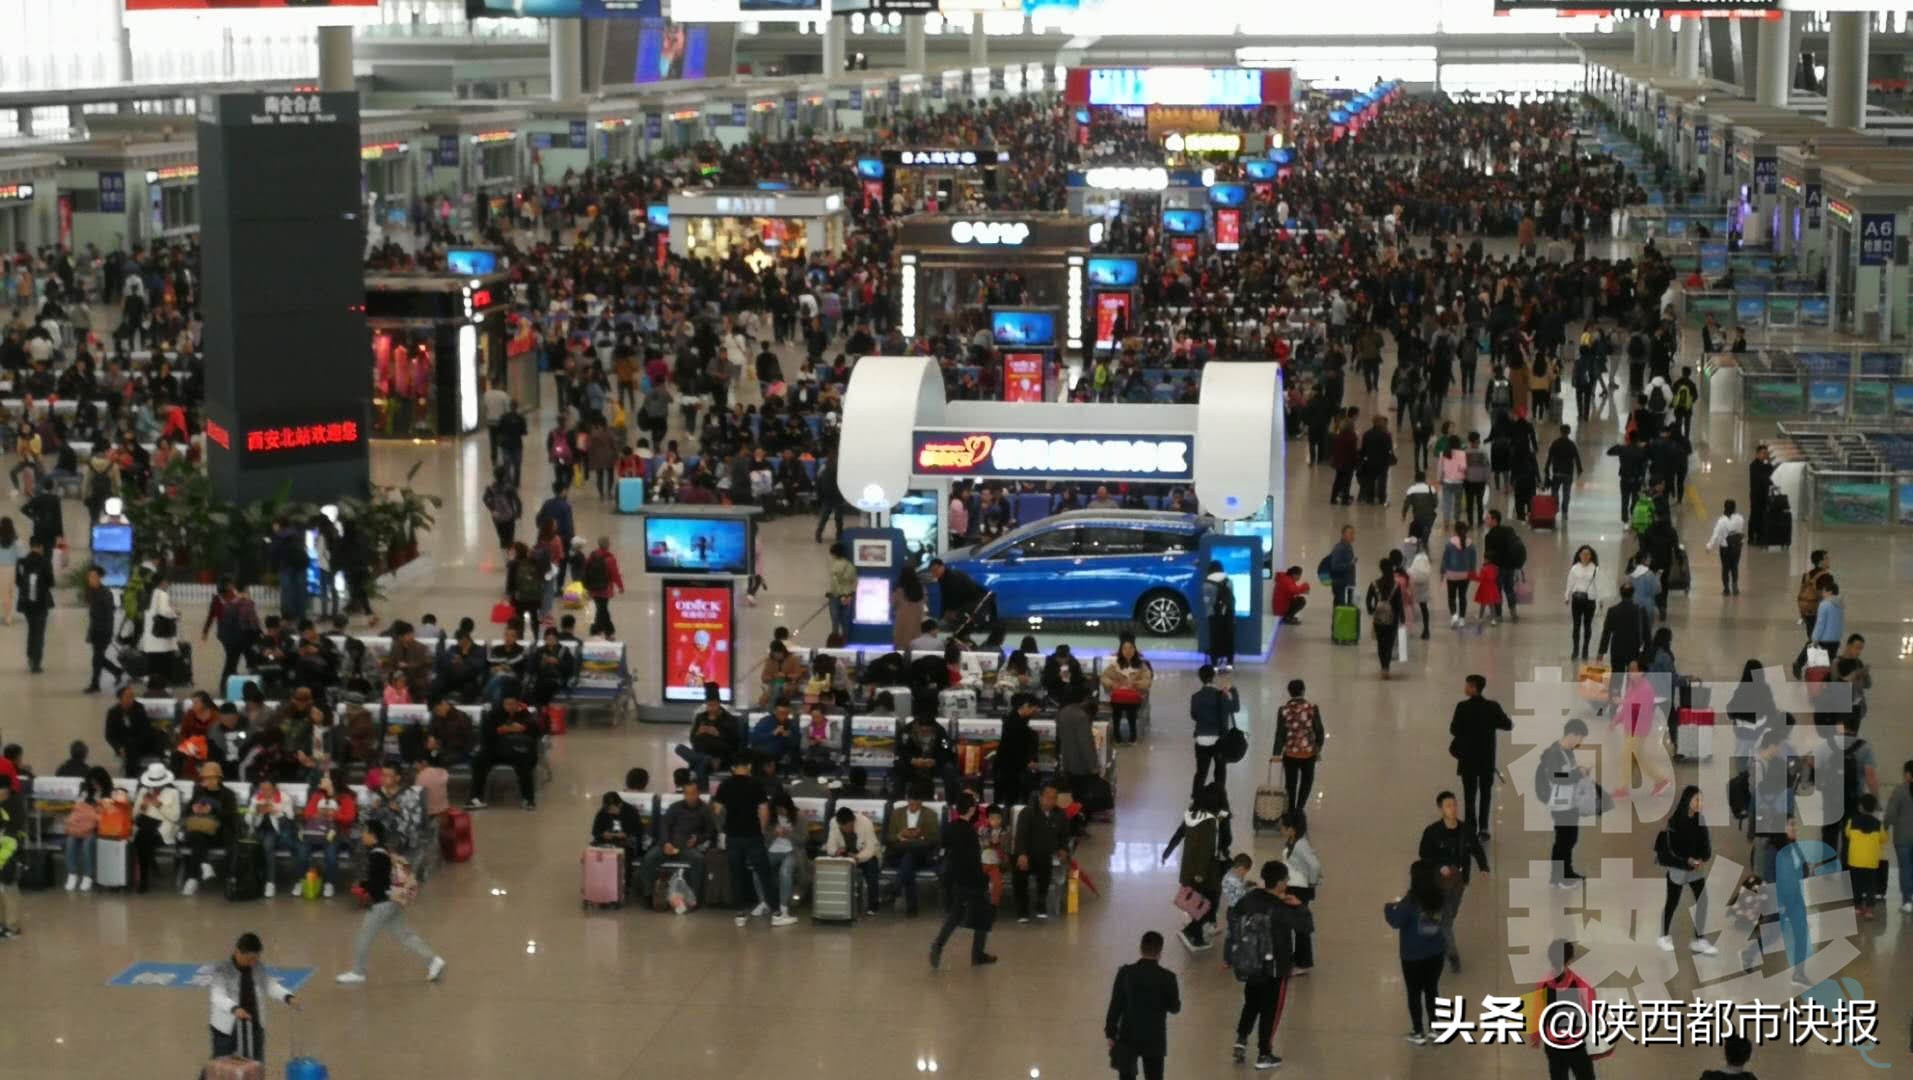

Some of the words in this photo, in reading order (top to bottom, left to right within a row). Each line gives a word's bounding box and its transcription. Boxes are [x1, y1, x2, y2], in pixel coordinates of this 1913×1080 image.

[1865, 221, 1892, 237] A6
[247, 420, 358, 451] 西安北站欢迎您
